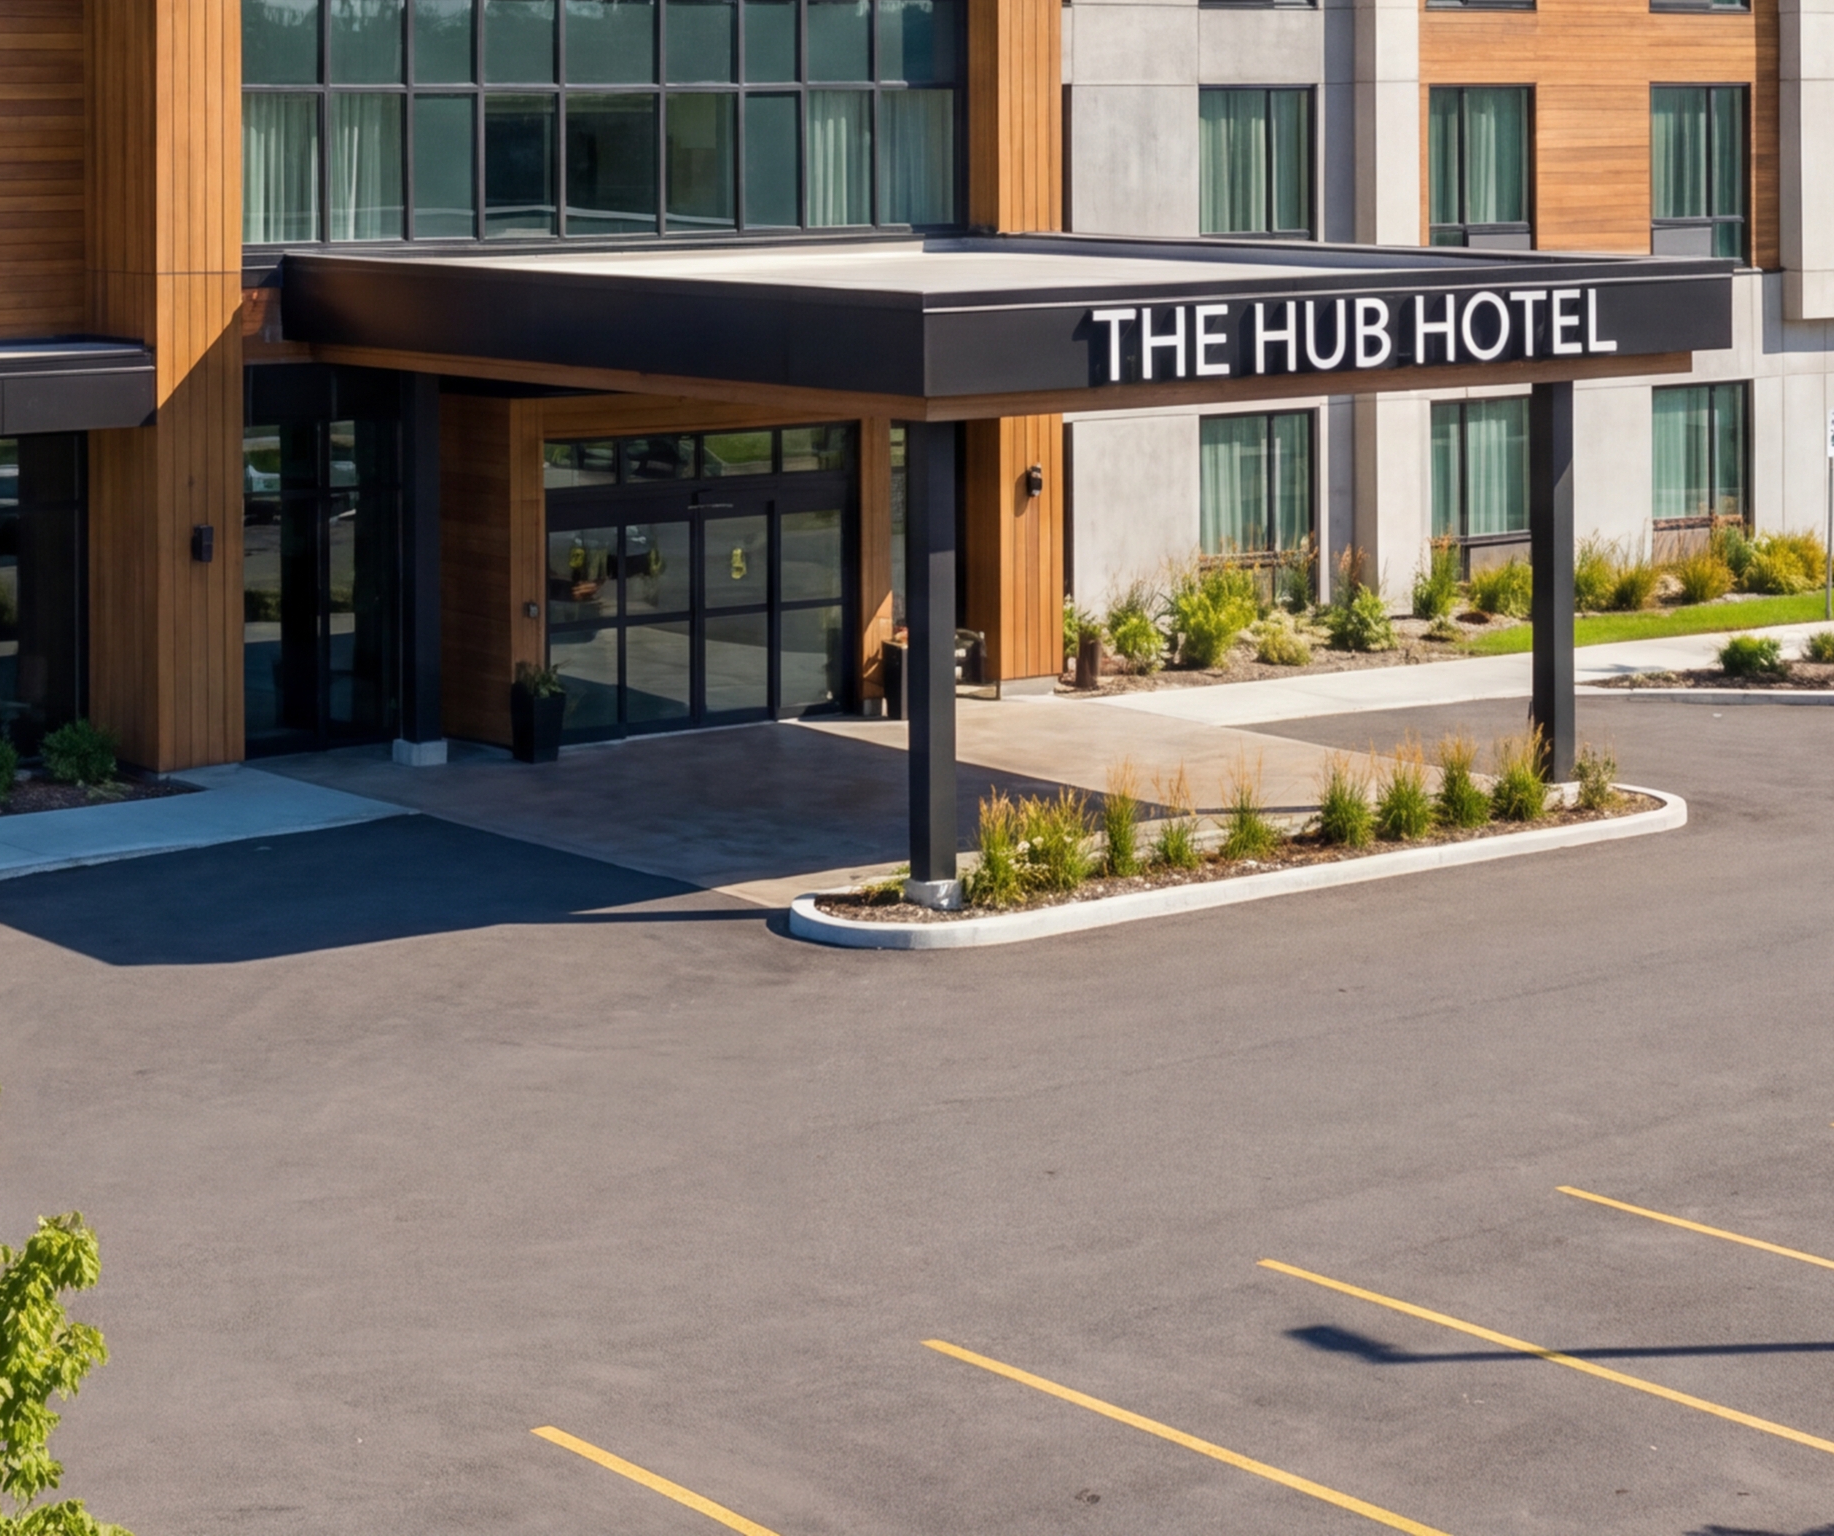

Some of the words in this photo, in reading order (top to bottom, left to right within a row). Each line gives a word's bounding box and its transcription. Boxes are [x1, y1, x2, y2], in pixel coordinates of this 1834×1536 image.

[1092, 304, 1231, 381] THE
[1254, 297, 1392, 374] HUB
[1415, 288, 1618, 364] HOTEL
